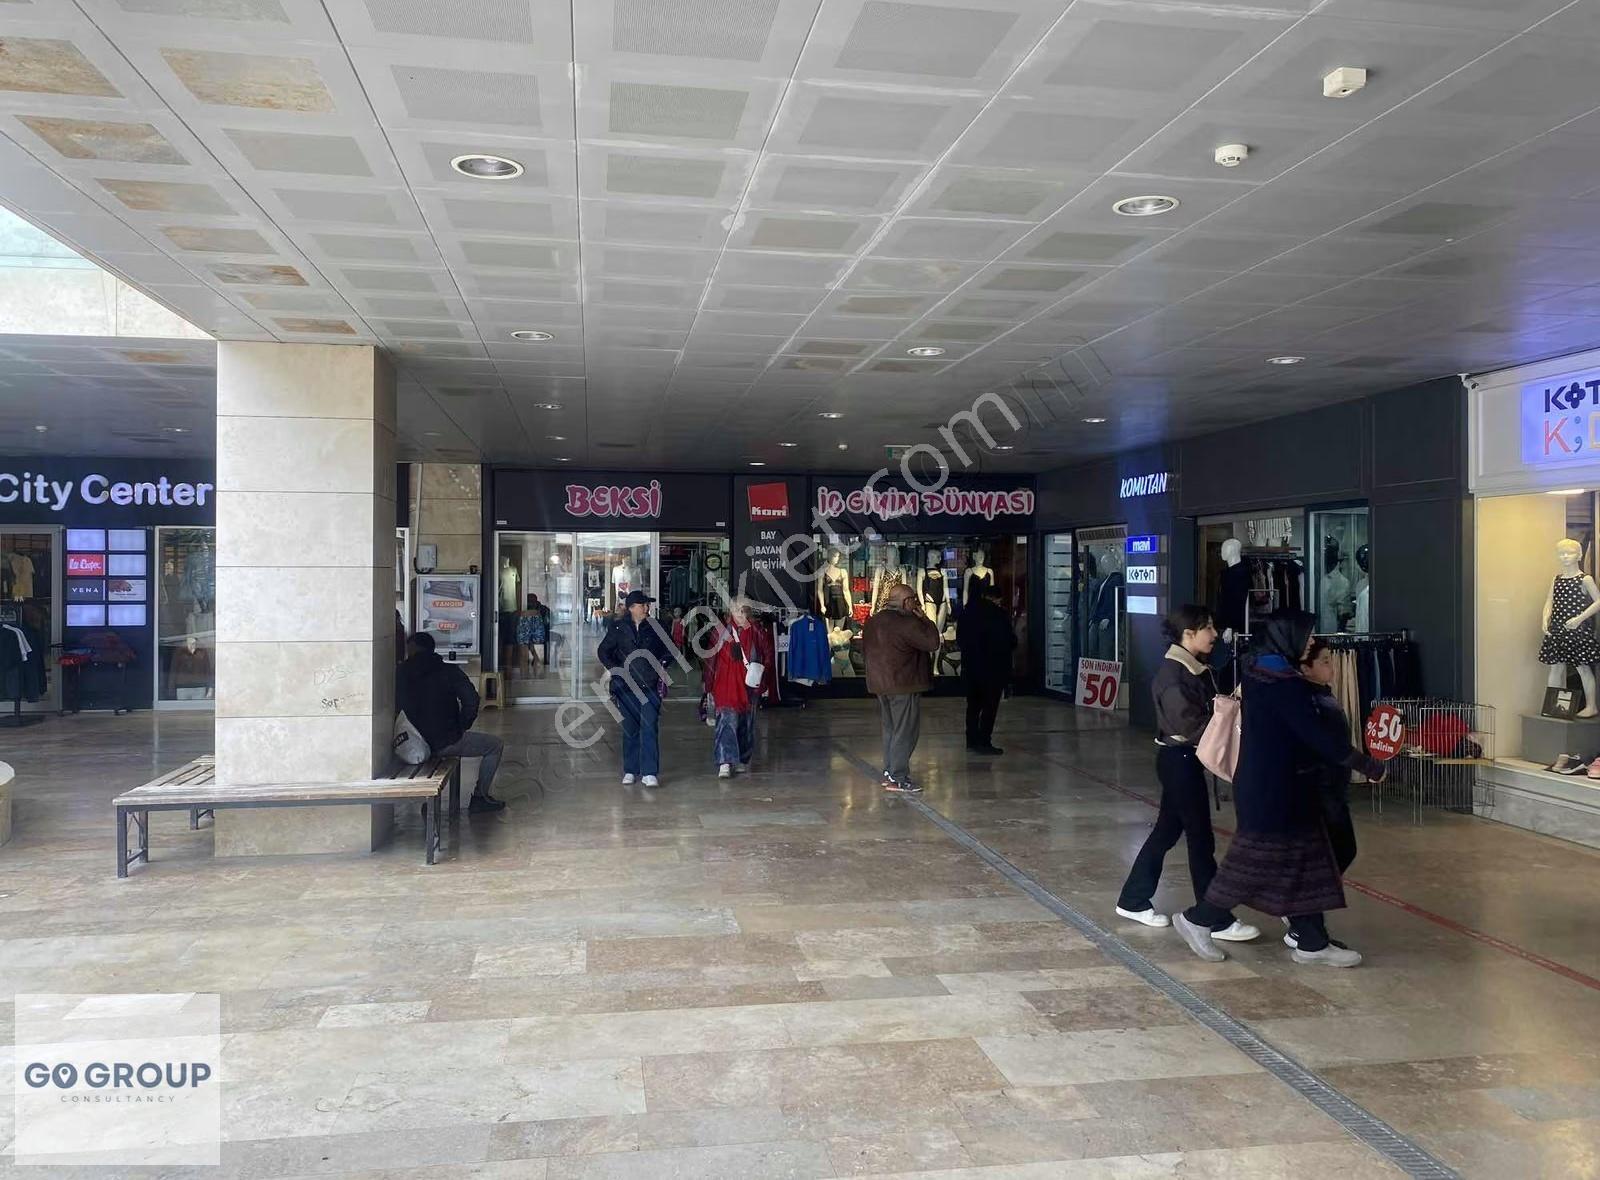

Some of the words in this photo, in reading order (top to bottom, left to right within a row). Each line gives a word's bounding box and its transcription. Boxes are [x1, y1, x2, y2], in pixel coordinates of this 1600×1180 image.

[0, 472, 73, 511] City
[81, 474, 213, 506] Center
[1120, 472, 1168, 498] KOMUTAN
[565, 480, 662, 518] BEKSİ
[923, 487, 1034, 521] DÜNYASI
[761, 531, 776, 540] BAY
[1132, 537, 1151, 552] mavi
[755, 546, 782, 555] BAYAN
[1128, 569, 1155, 581] KOTON
[1081, 660, 1094, 670] SON
[1367, 712, 1402, 742] %50
